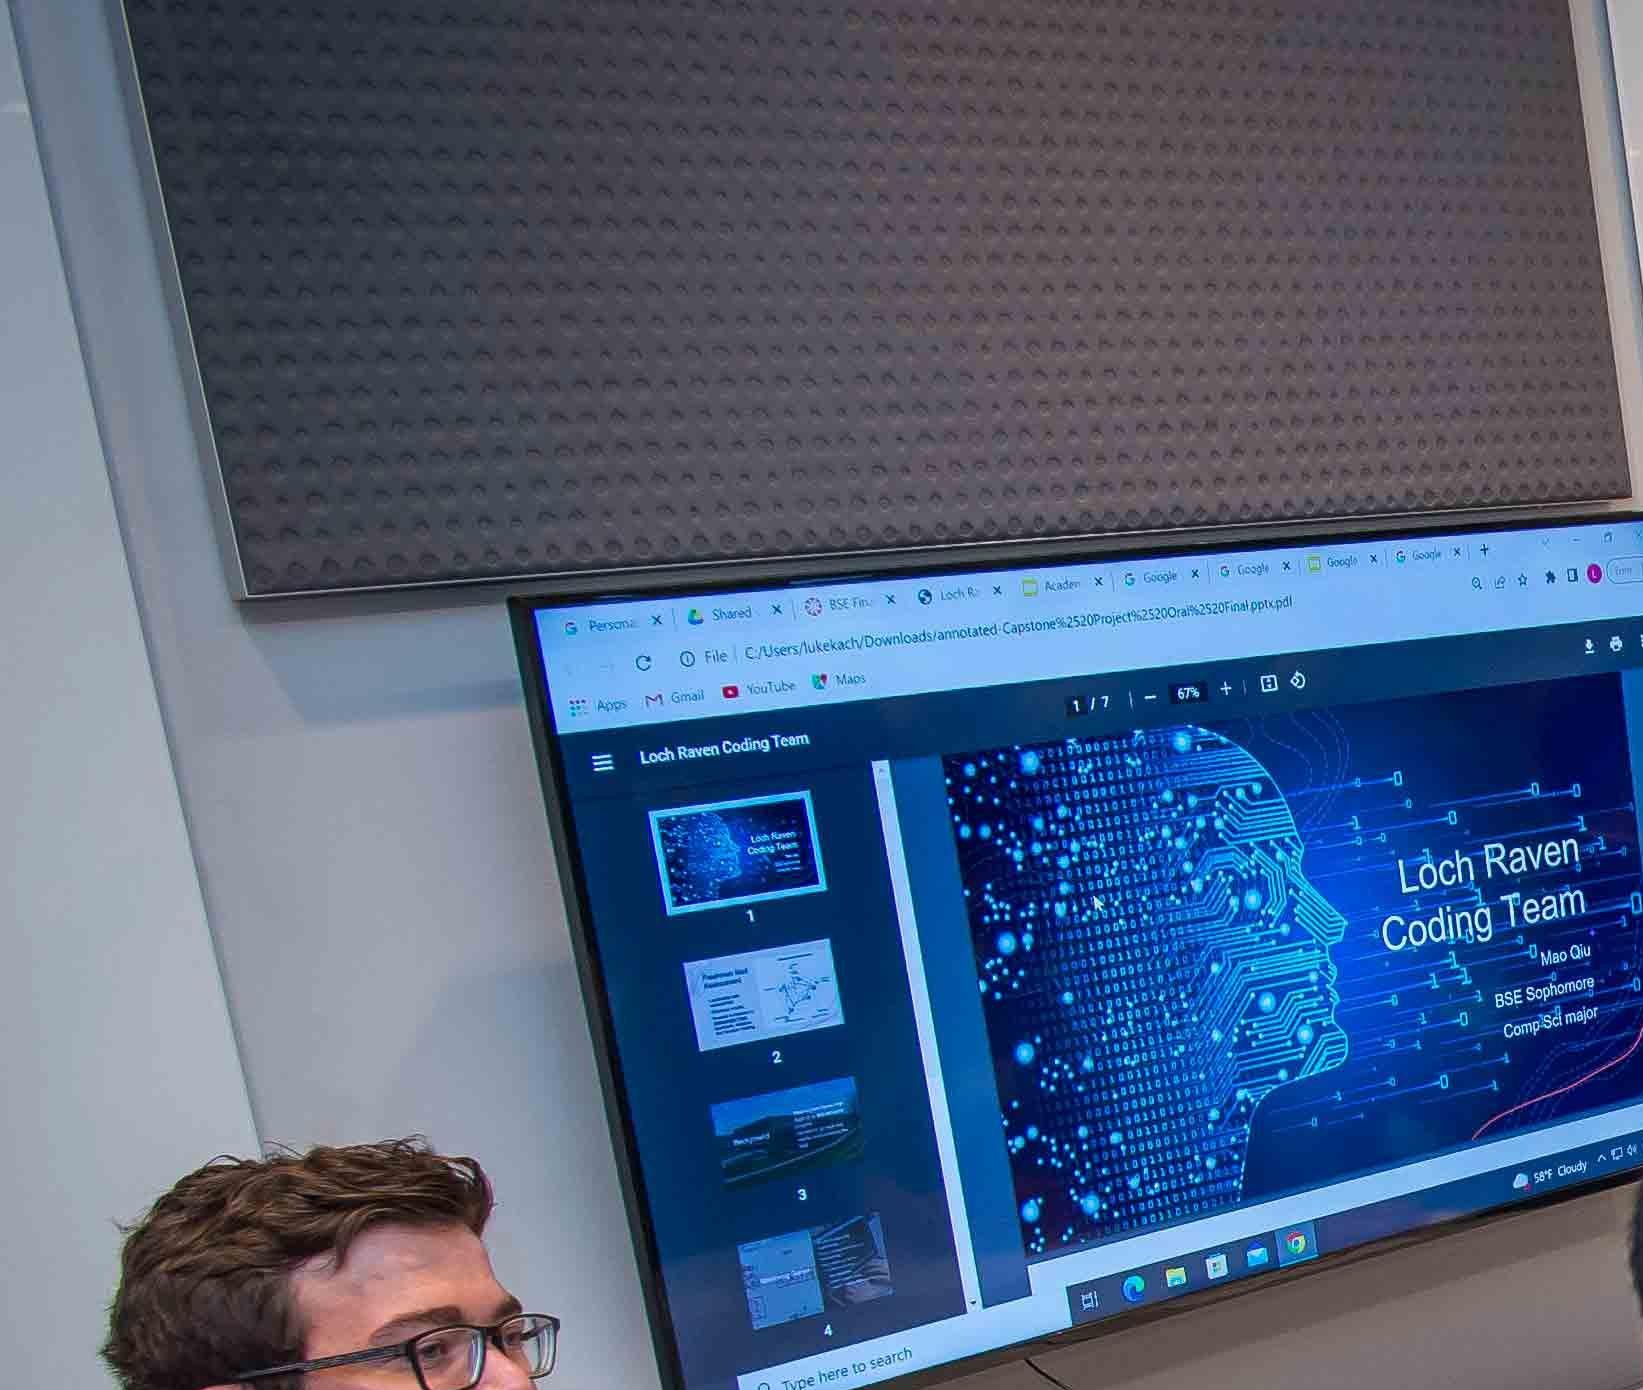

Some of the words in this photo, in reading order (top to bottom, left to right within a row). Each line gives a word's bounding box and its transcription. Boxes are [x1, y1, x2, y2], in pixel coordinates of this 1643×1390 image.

[1237, 562, 1270, 577] Google
[1327, 556, 1358, 569] Google
[1143, 570, 1178, 585] Google
[711, 607, 752, 621] Shared
[705, 650, 728, 663] File
[836, 673, 867, 687] Maps
[671, 689, 704, 704] Gmail
[747, 681, 796, 697] YouTube
[1177, 686, 1200, 700] 67%
[597, 700, 628, 714] Apps
[640, 748, 674, 766] Loch
[678, 743, 720, 761] Raven
[722, 738, 770, 756] Coding
[771, 732, 810, 749] Team
[1398, 849, 1475, 894] Loch
[1484, 837, 1580, 878] Raven
[1382, 903, 1493, 951] Coding
[1499, 889, 1586, 928] Team
[1541, 950, 1567, 967] Mao
[1570, 944, 1591, 960] Qiu
[1495, 989, 1523, 1009] BSE
[1526, 977, 1595, 1004] Sophomore
[1503, 1019, 1541, 1040] Comp
[1543, 1013, 1562, 1030] Sci
[1565, 1006, 1599, 1027] major
[772, 1051, 782, 1064] 2
[1557, 1160, 1588, 1177] Cloudy
[819, 1366, 849, 1385] here
[851, 1359, 867, 1374] to
[870, 1347, 913, 1370] search
